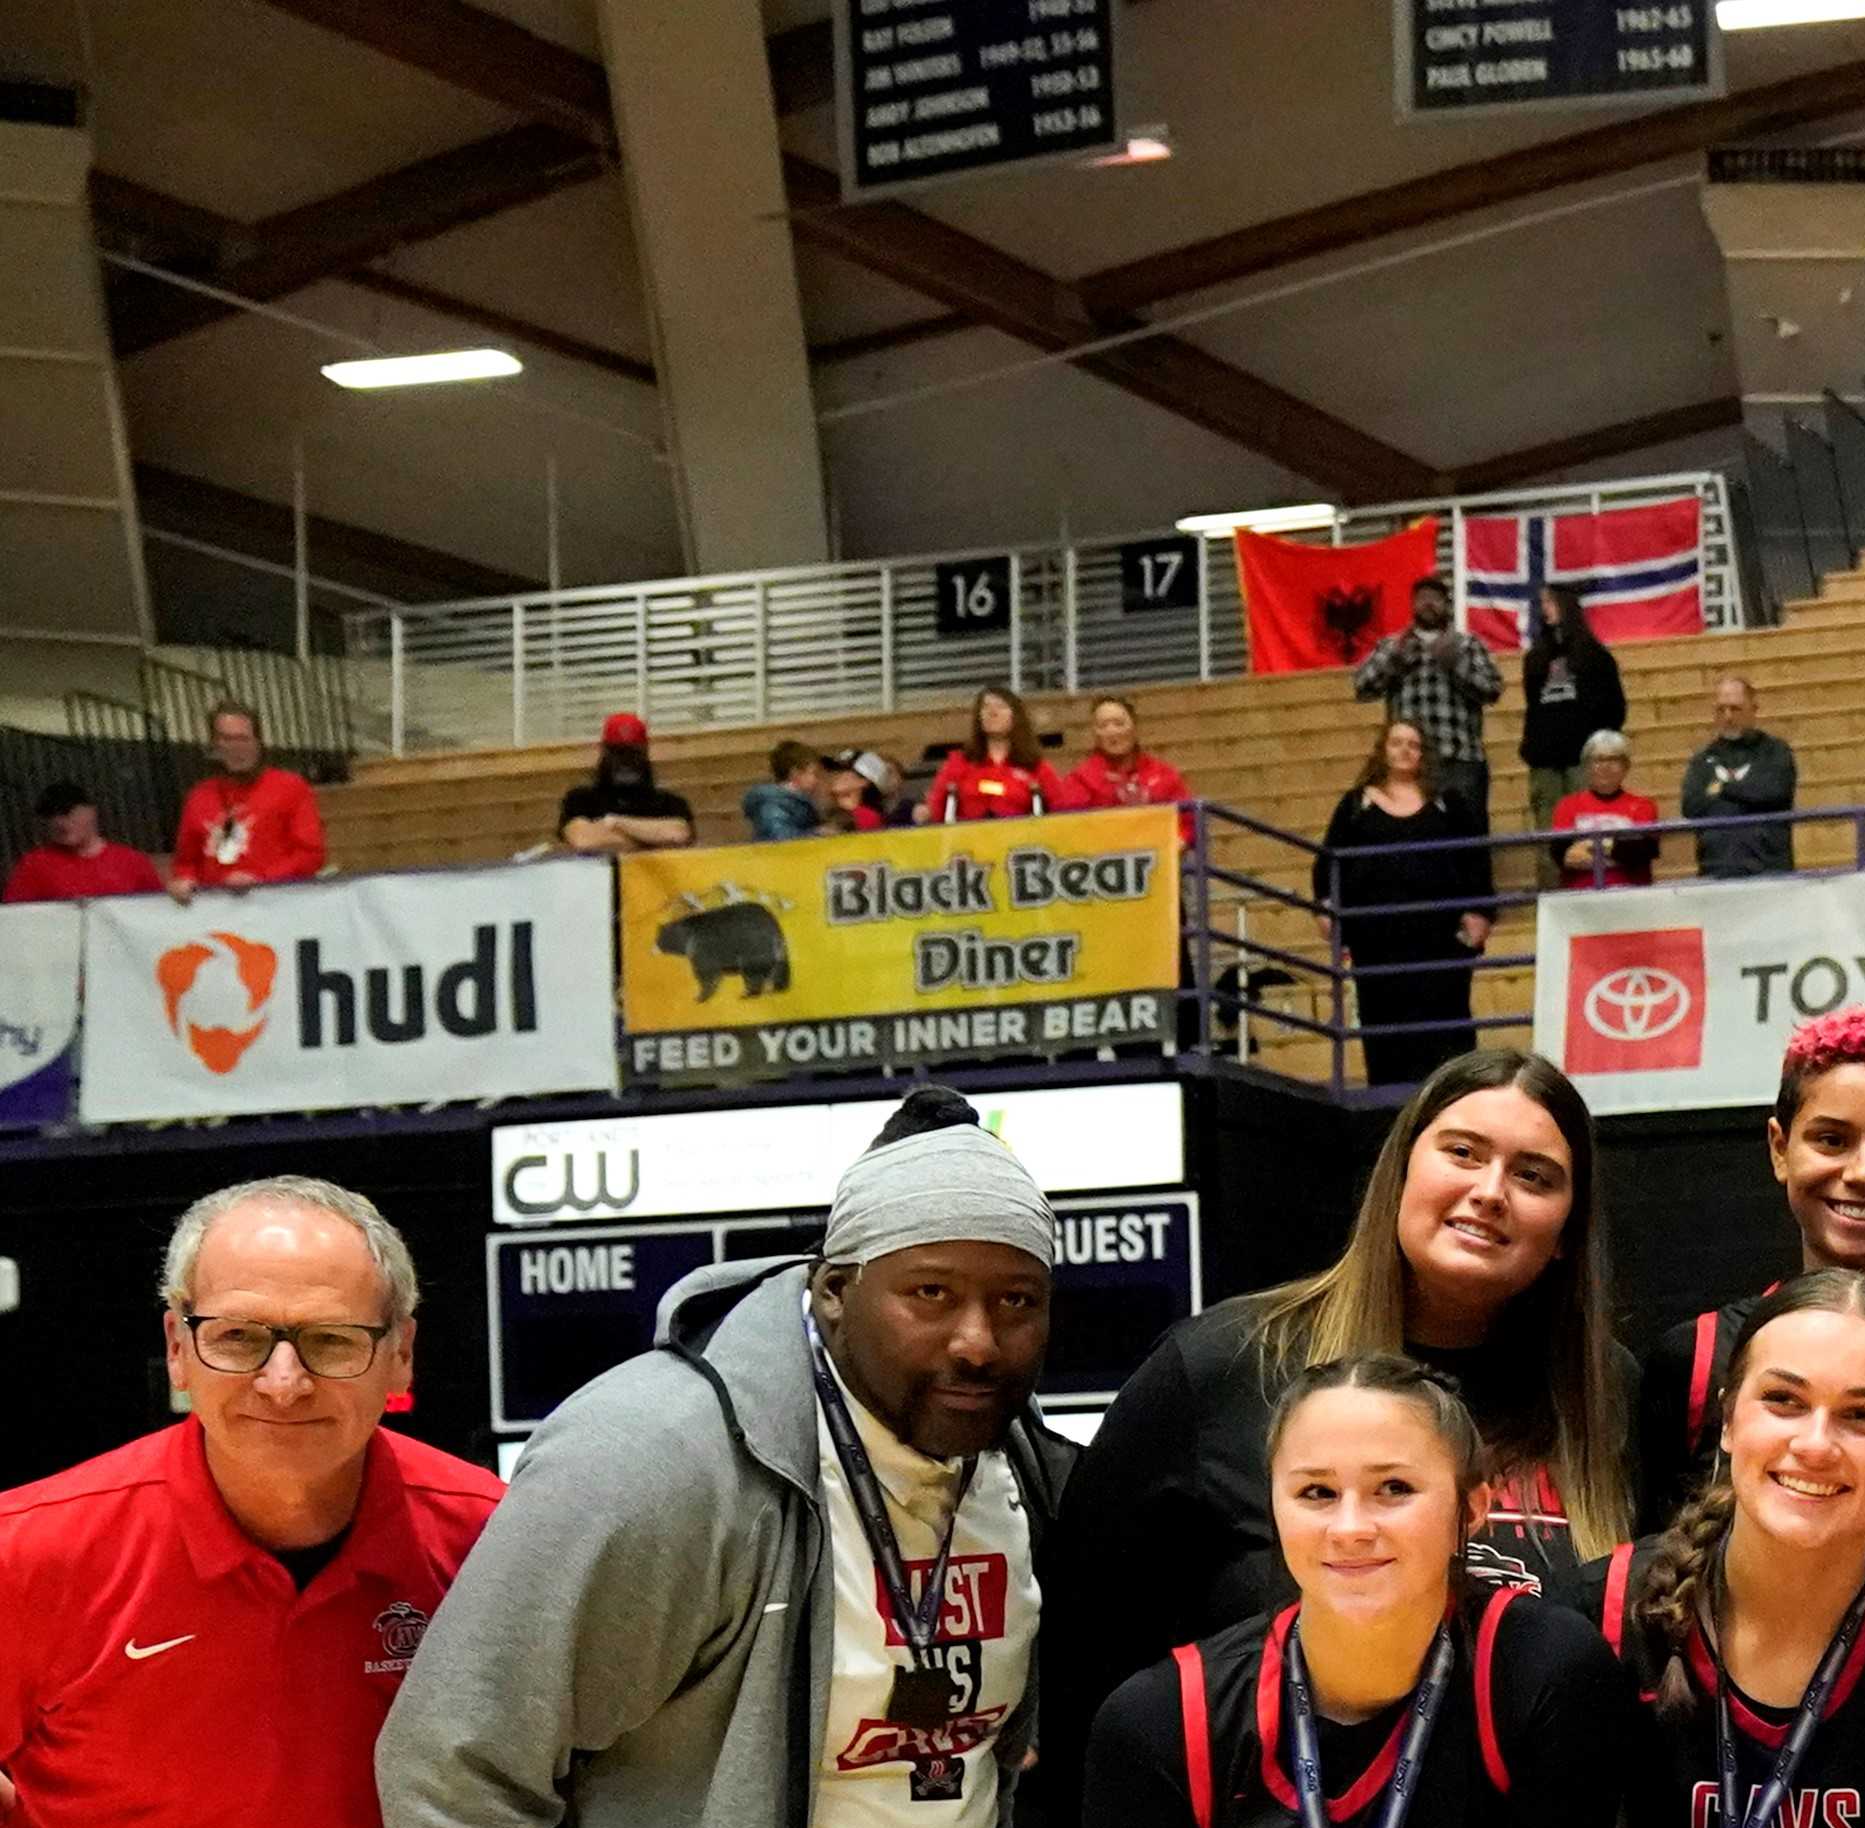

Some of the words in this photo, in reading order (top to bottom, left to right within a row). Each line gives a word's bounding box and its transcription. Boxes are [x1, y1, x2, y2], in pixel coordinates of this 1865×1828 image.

[951, 572, 994, 615] 16
[1140, 550, 1184, 598] 17
[825, 856, 995, 925] Black
[1009, 847, 1157, 907] Bear
[297, 922, 538, 1048] hudl
[914, 930, 1081, 994] Diner
[634, 1036, 740, 1073] FEED
[759, 1026, 875, 1062] YOUR
[896, 1012, 1027, 1053] INNER
[1043, 997, 1159, 1039] BEAR
[519, 1244, 635, 1294] HOME
